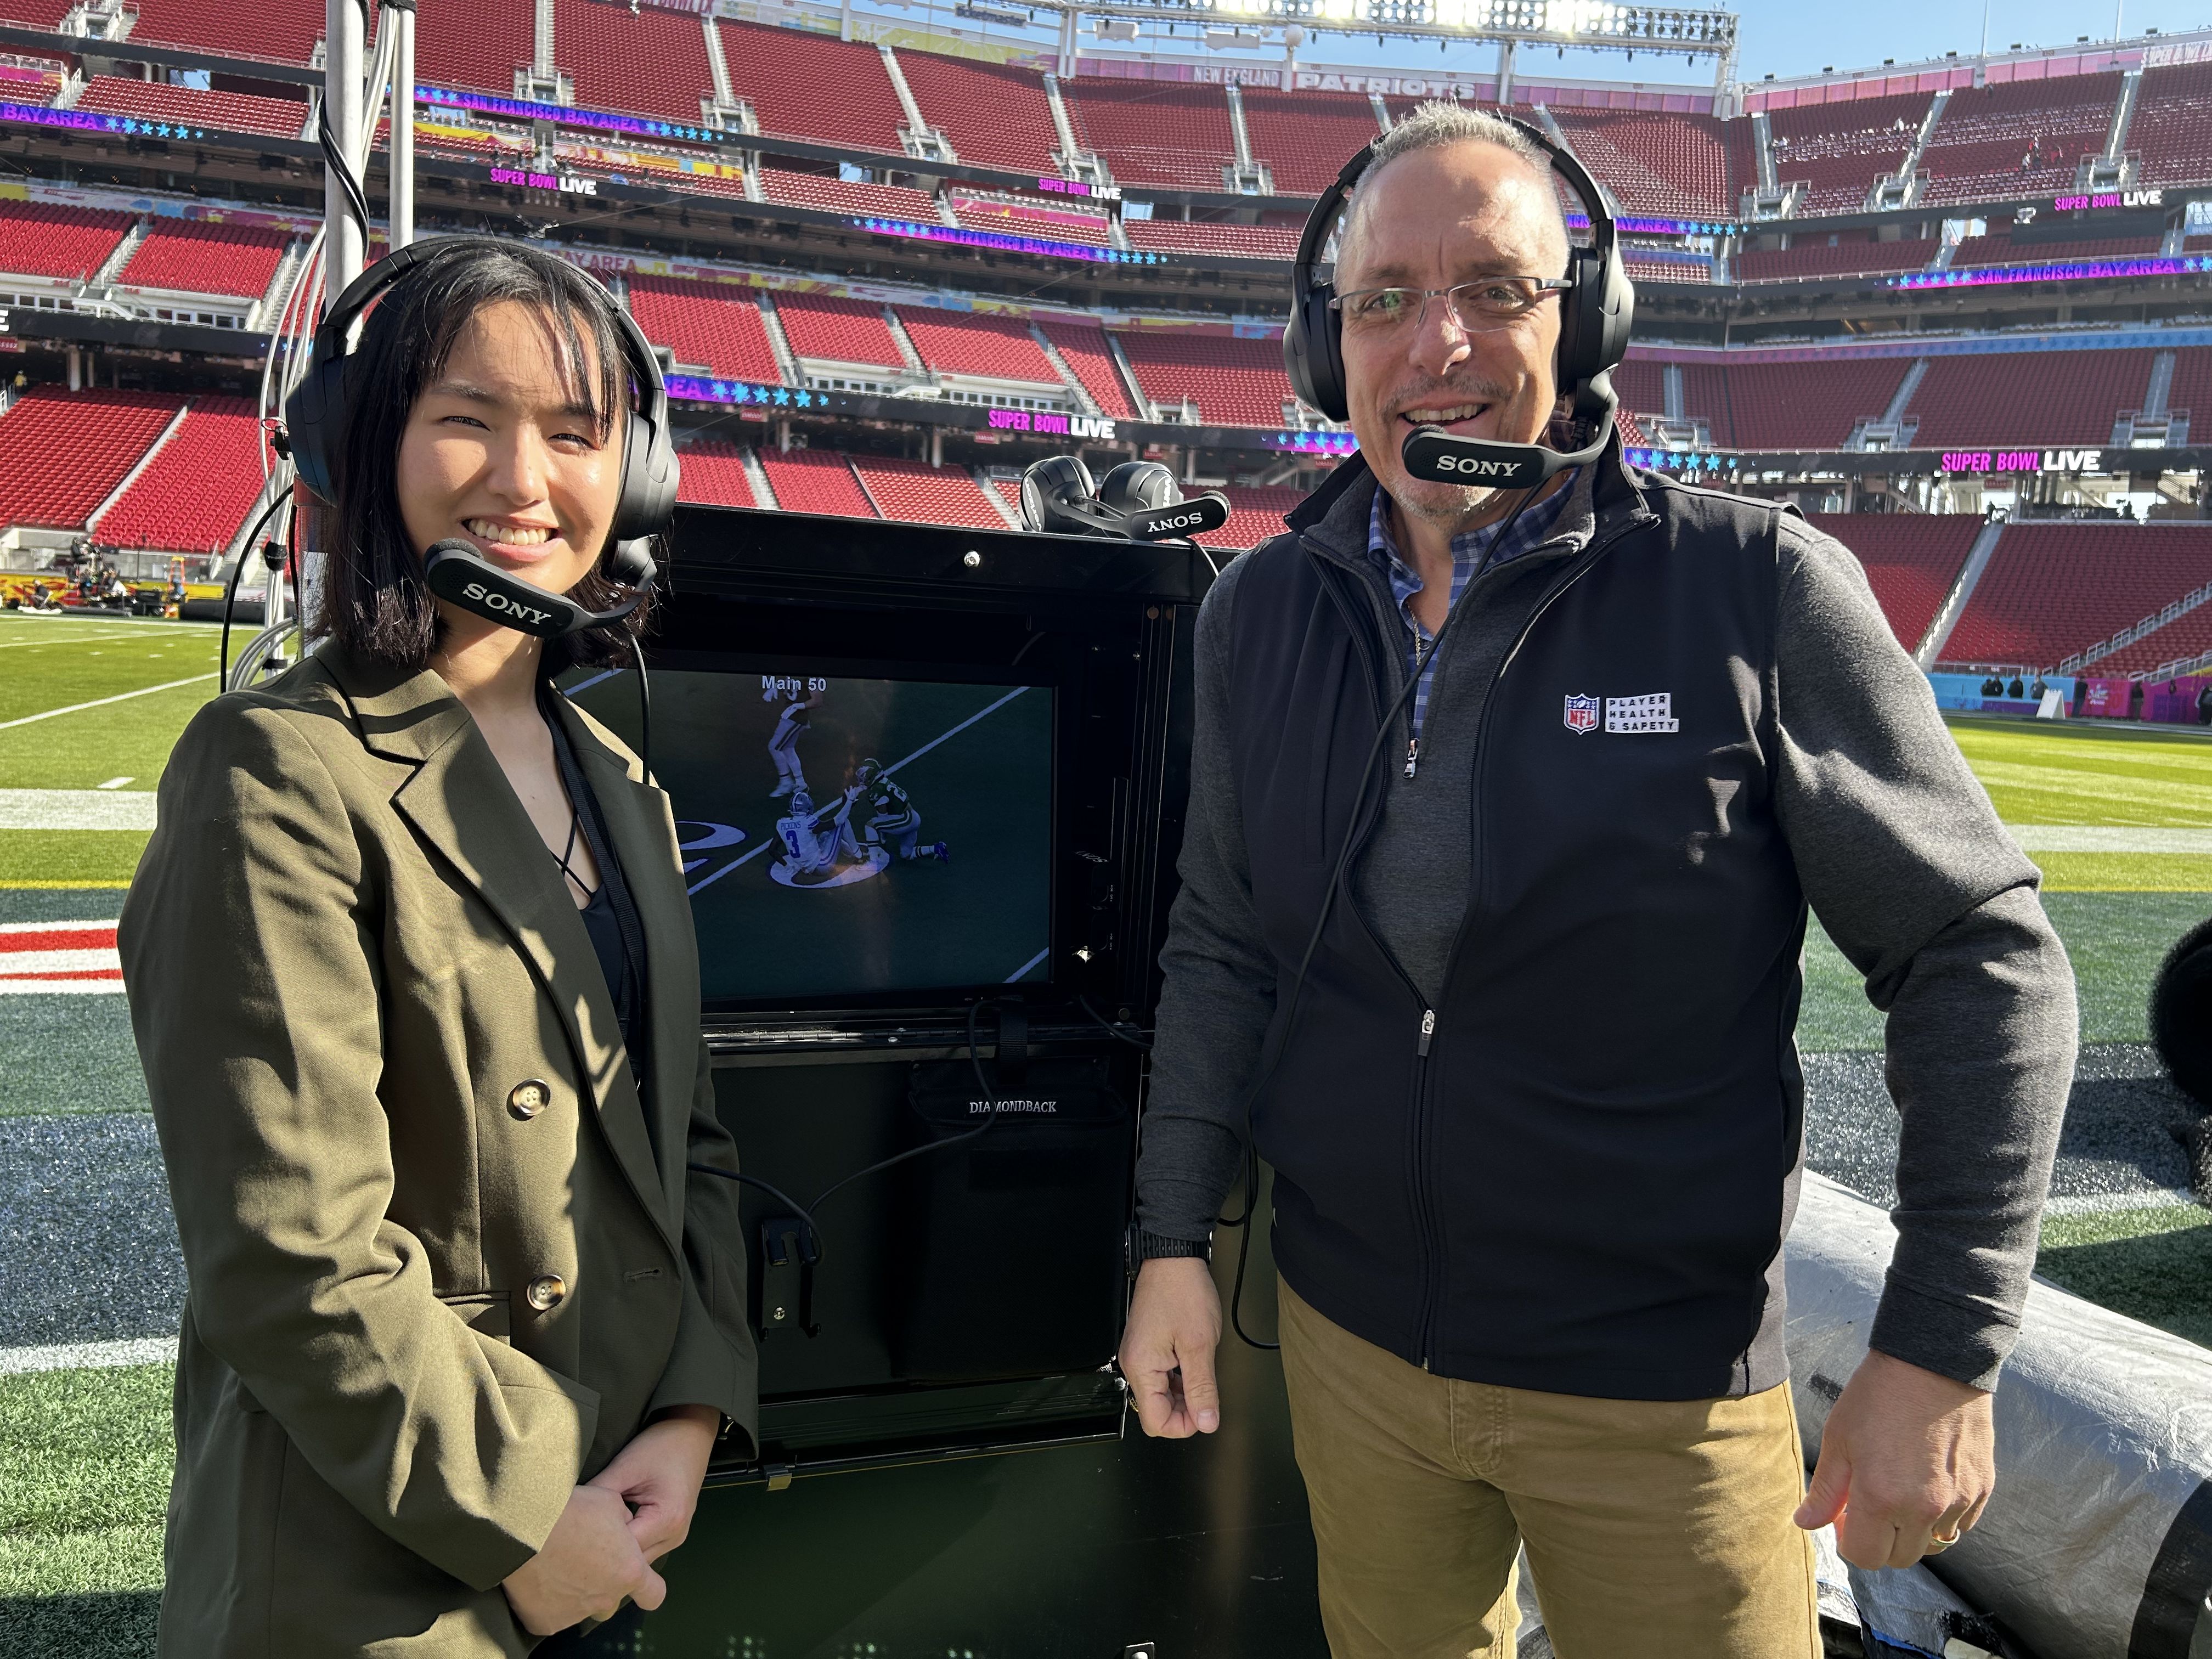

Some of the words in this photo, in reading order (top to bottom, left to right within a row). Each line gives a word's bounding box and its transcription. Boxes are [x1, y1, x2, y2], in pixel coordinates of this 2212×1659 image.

[1194, 66, 1222, 83] NEW
[1296, 73, 1475, 99] PATRIOTS
[3, 103, 43, 122] BAY
[46, 110, 98, 130] AREA
[463, 94, 488, 110] SAN
[493, 98, 561, 121] FRANCISCO
[565, 109, 597, 126] BAY
[597, 114, 641, 133] AREA
[490, 167, 526, 186] SUPER
[528, 173, 558, 190] BOWL
[559, 177, 597, 195] LIVE
[1038, 178, 1066, 193] SUPER
[1067, 182, 1091, 196] BOWL
[1091, 185, 1122, 200] LIVE
[2054, 195, 2089, 211] SUPER
[2091, 193, 2121, 208] BOWL
[2123, 190, 2163, 206] LIVE
[590, 253, 637, 273] AREA
[1978, 268, 2002, 284] SAN
[2008, 264, 2083, 283] FRANCISCO
[2088, 262, 2125, 276] BAY
[2126, 260, 2176, 275] AREA
[989, 410, 1030, 431] SUPER
[1034, 414, 1070, 435] BOWL
[1070, 417, 1116, 439] LIVE
[1436, 455, 1522, 477] SONY
[1941, 452, 1991, 472] SUPER
[1996, 452, 2041, 471] BOWL
[2044, 450, 2101, 471] LIVE
[1147, 512, 1203, 533] SONY
[462, 583, 552, 624] SONY
[762, 675, 802, 691] Main
[808, 678, 826, 692] 50
[1609, 696, 1666, 707] PLAYER
[1568, 710, 1595, 727] NFL
[1609, 708, 1666, 718] HEALTH
[1623, 721, 1673, 731] SAFETY
[786, 830, 801, 859] 3
[969, 1100, 1058, 1114] DIAMONDBACK
